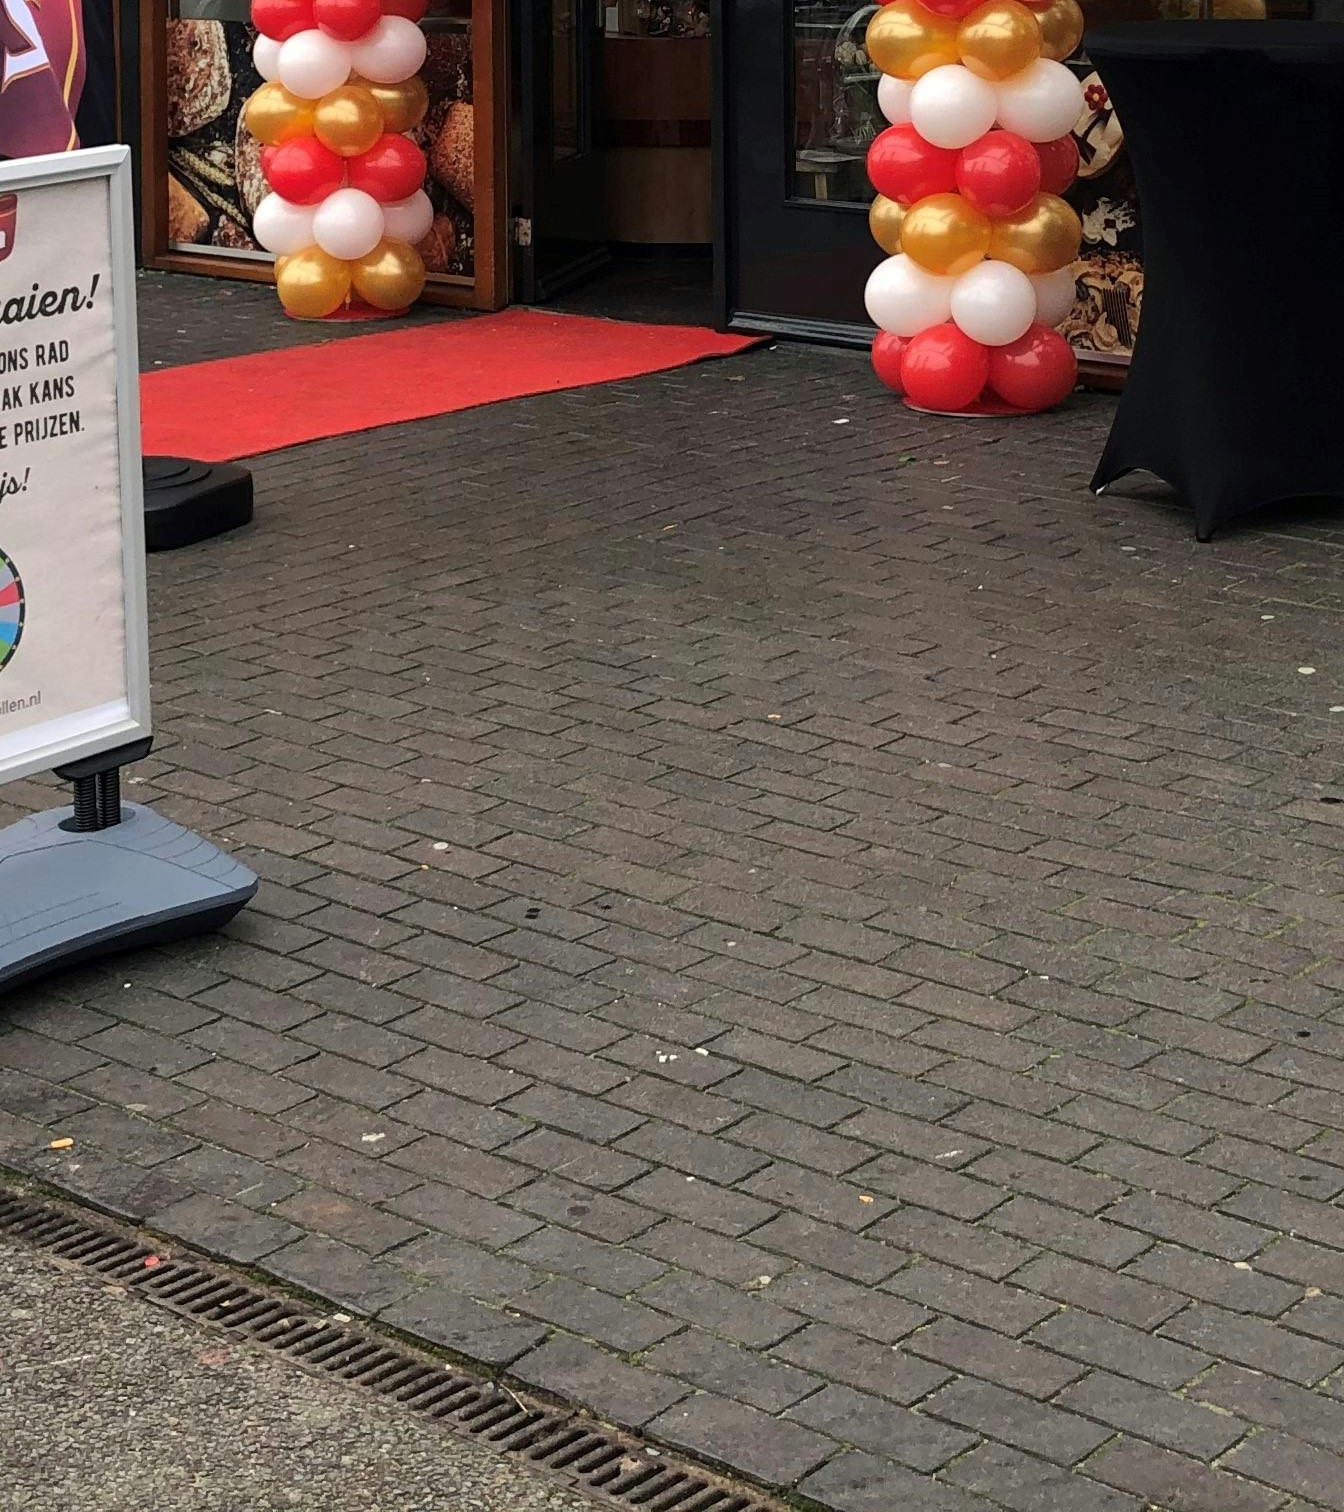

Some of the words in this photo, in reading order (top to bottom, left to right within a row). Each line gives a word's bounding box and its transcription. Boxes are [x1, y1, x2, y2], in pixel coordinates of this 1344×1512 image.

[35, 340, 70, 366] RAD
[29, 375, 76, 405] KANS
[13, 410, 86, 446] PRIJZEN.
